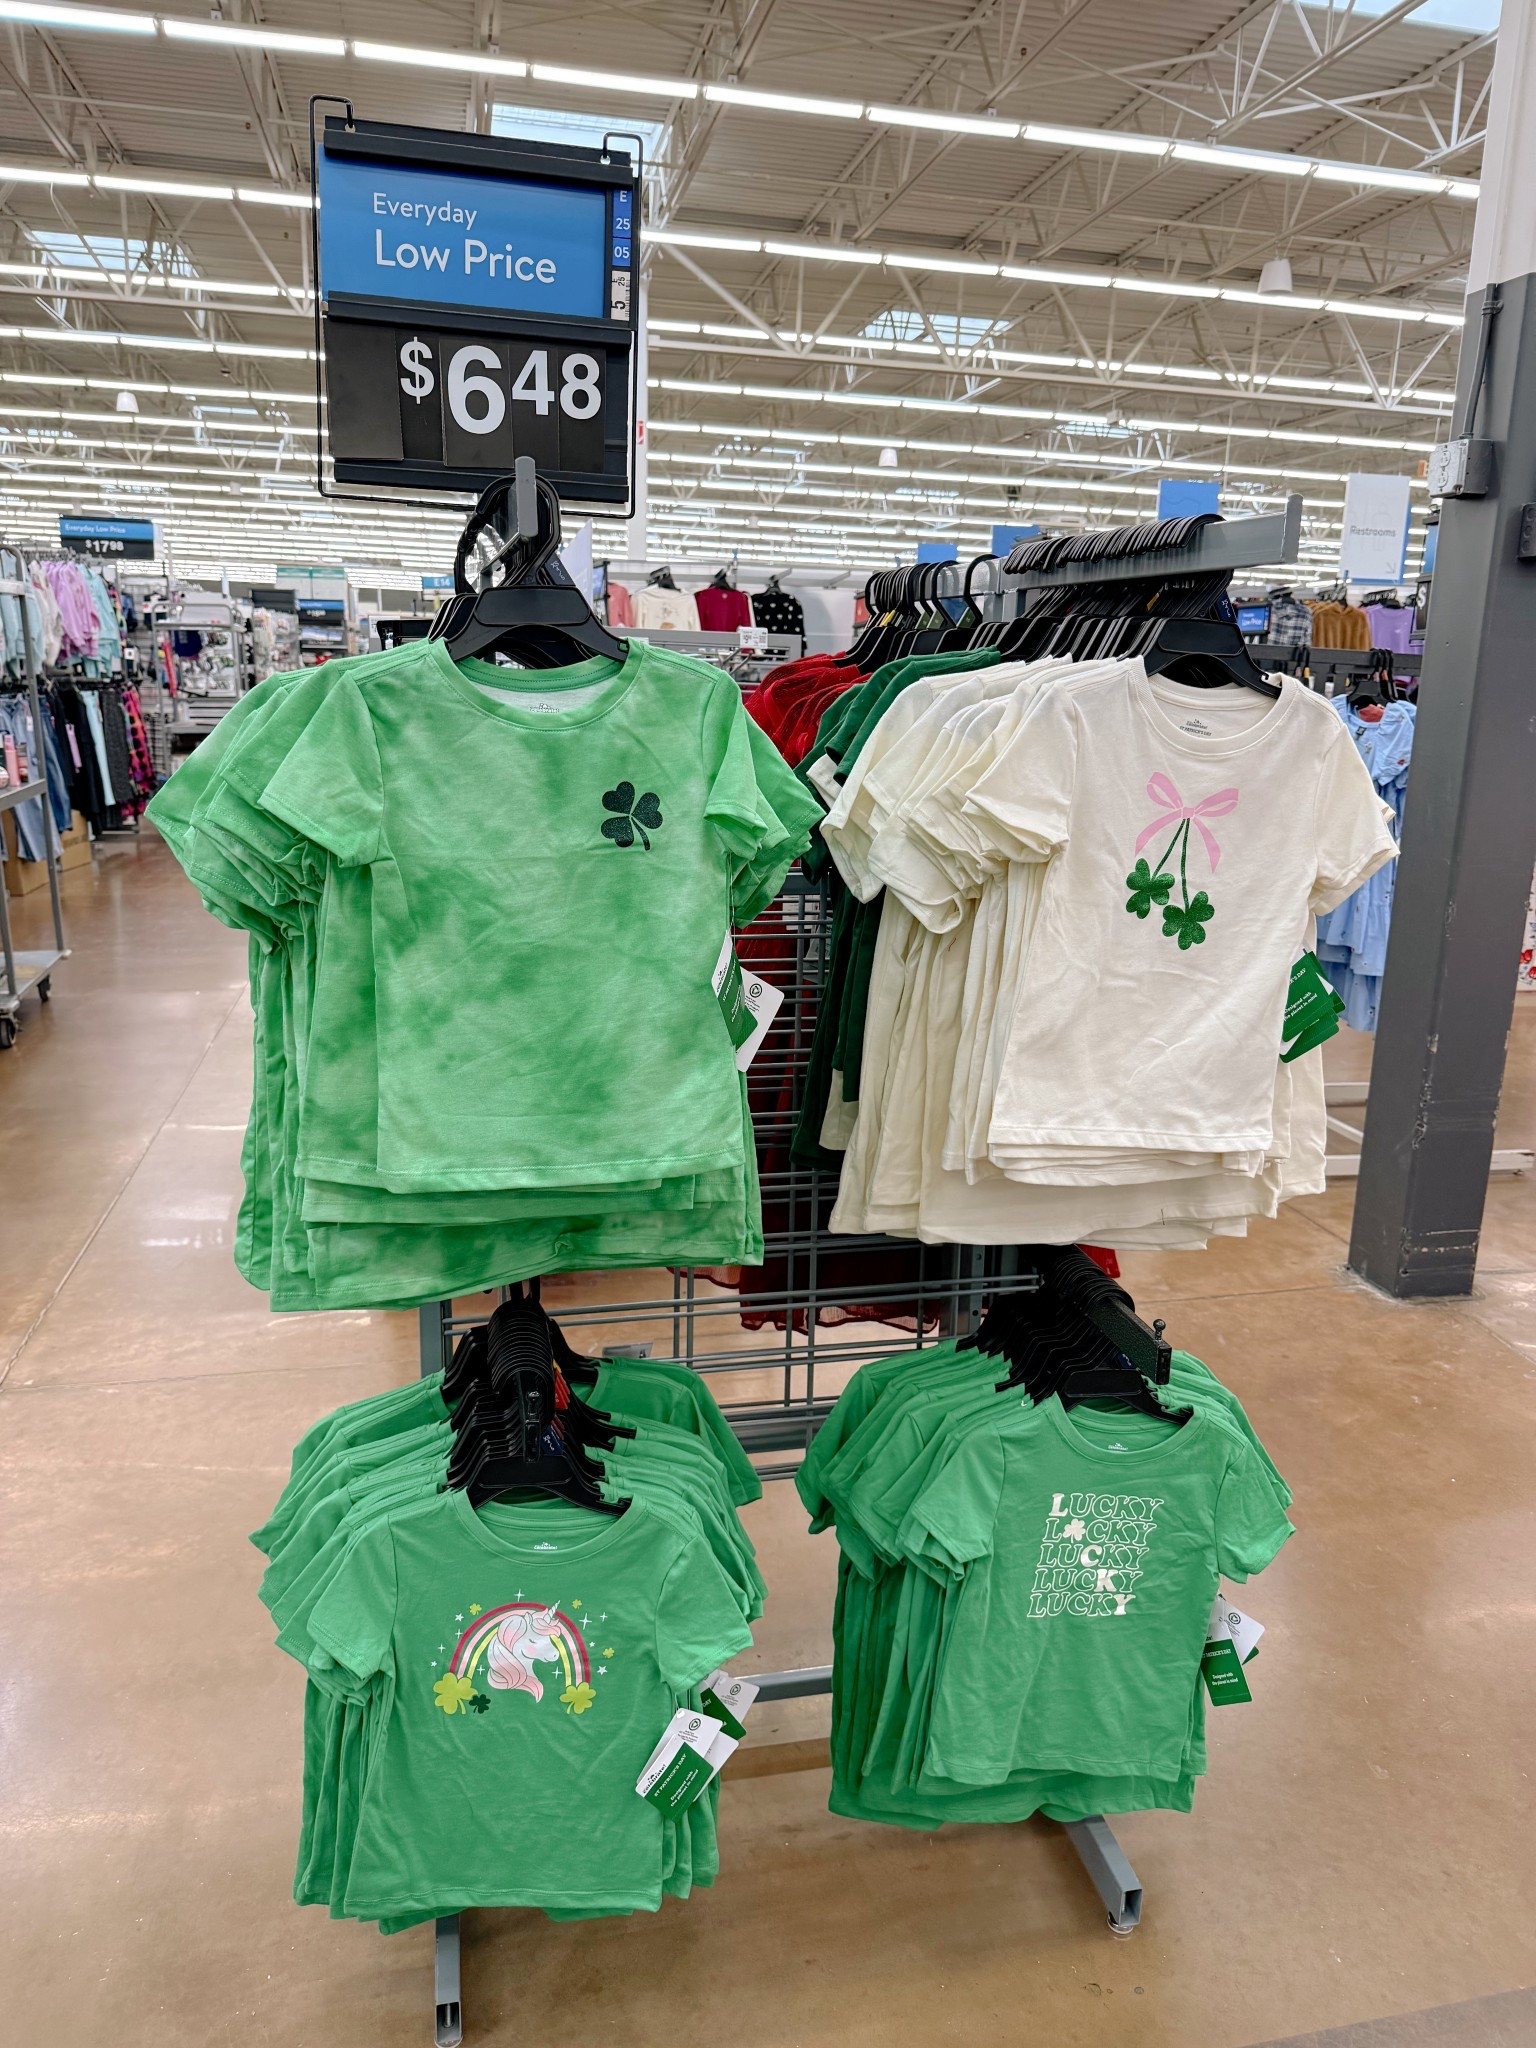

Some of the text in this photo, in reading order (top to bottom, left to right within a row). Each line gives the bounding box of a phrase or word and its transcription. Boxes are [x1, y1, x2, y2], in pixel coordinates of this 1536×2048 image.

[373, 192, 477, 231] Everyday
[615, 217, 631, 231] 25
[375, 228, 557, 284] Low Price
[613, 246, 630, 259] 05
[65, 524, 126, 534] Everyday Low Price
[1349, 525, 1396, 538] Restrooms
[1048, 1492, 1164, 1522] LUCKY
[1037, 1543, 1150, 1570] LUCKY
[1031, 1568, 1144, 1593] LUCKY
[1027, 1592, 1136, 1618] LUCKY
[660, 1764, 680, 1791] PATRICK'S
[677, 1753, 687, 1766] DAY
[670, 1780, 687, 1801] Designed
[677, 1785, 688, 1800] planet
